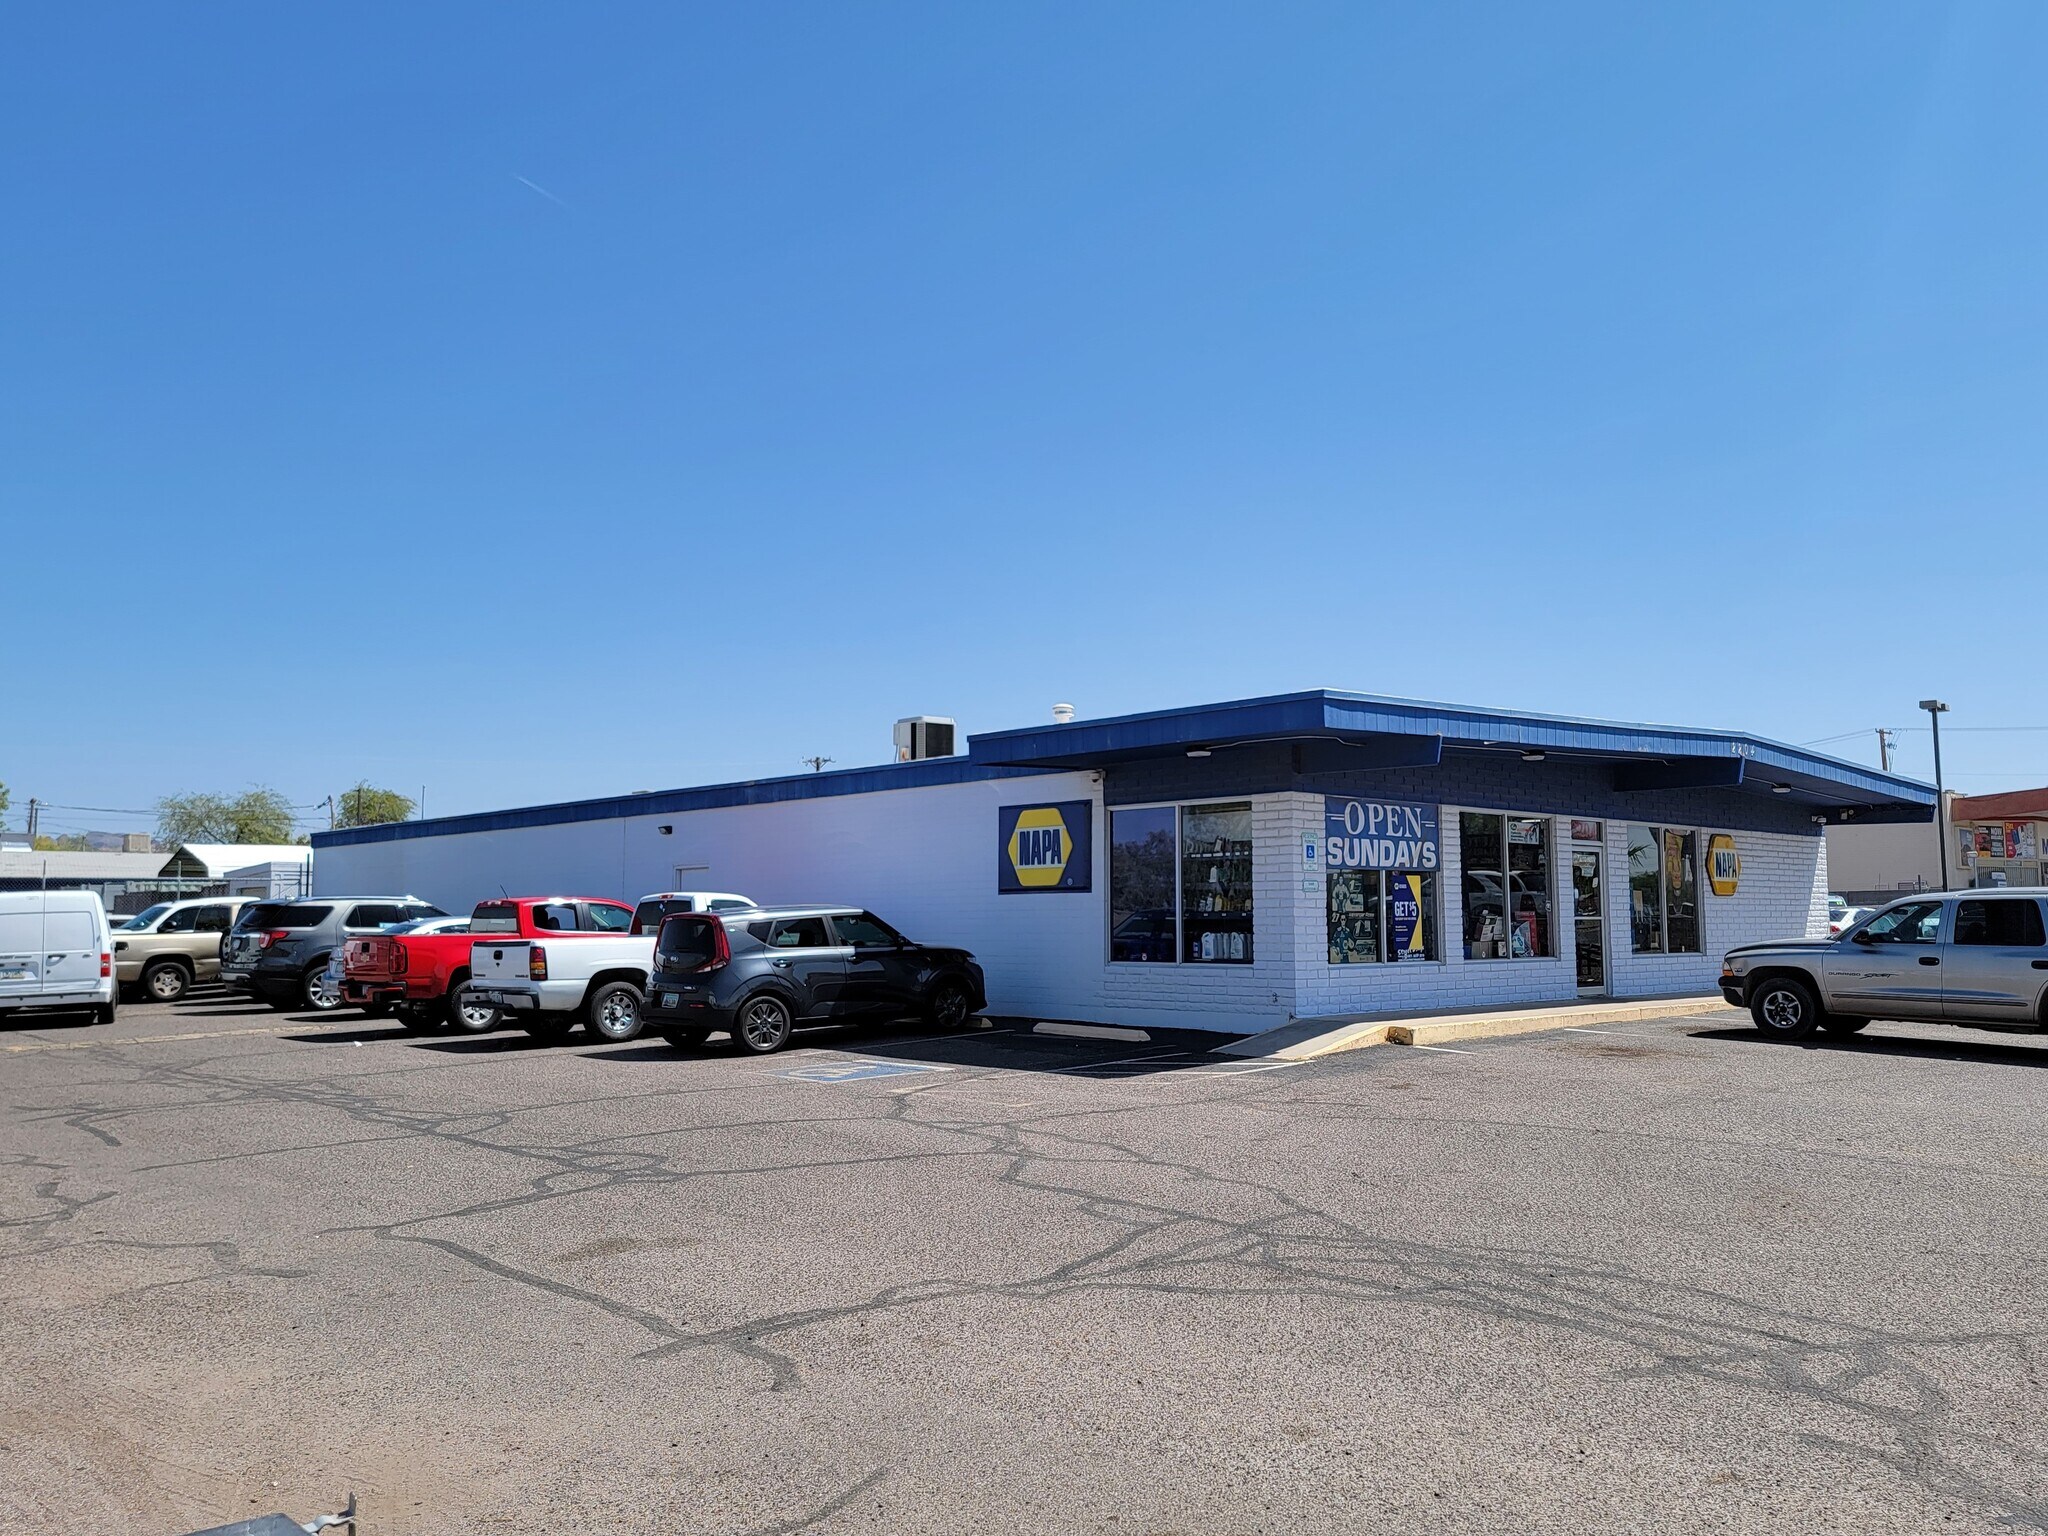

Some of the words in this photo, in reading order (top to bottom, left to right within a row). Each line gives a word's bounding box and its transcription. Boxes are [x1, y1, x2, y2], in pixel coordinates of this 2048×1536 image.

[1344, 801, 1422, 838] OPEN
[1019, 828, 1062, 866] NAPA
[1327, 836, 1437, 868] SUNDAYS
[1715, 851, 1737, 878] NAPA
[1394, 901, 1408, 917] GET
